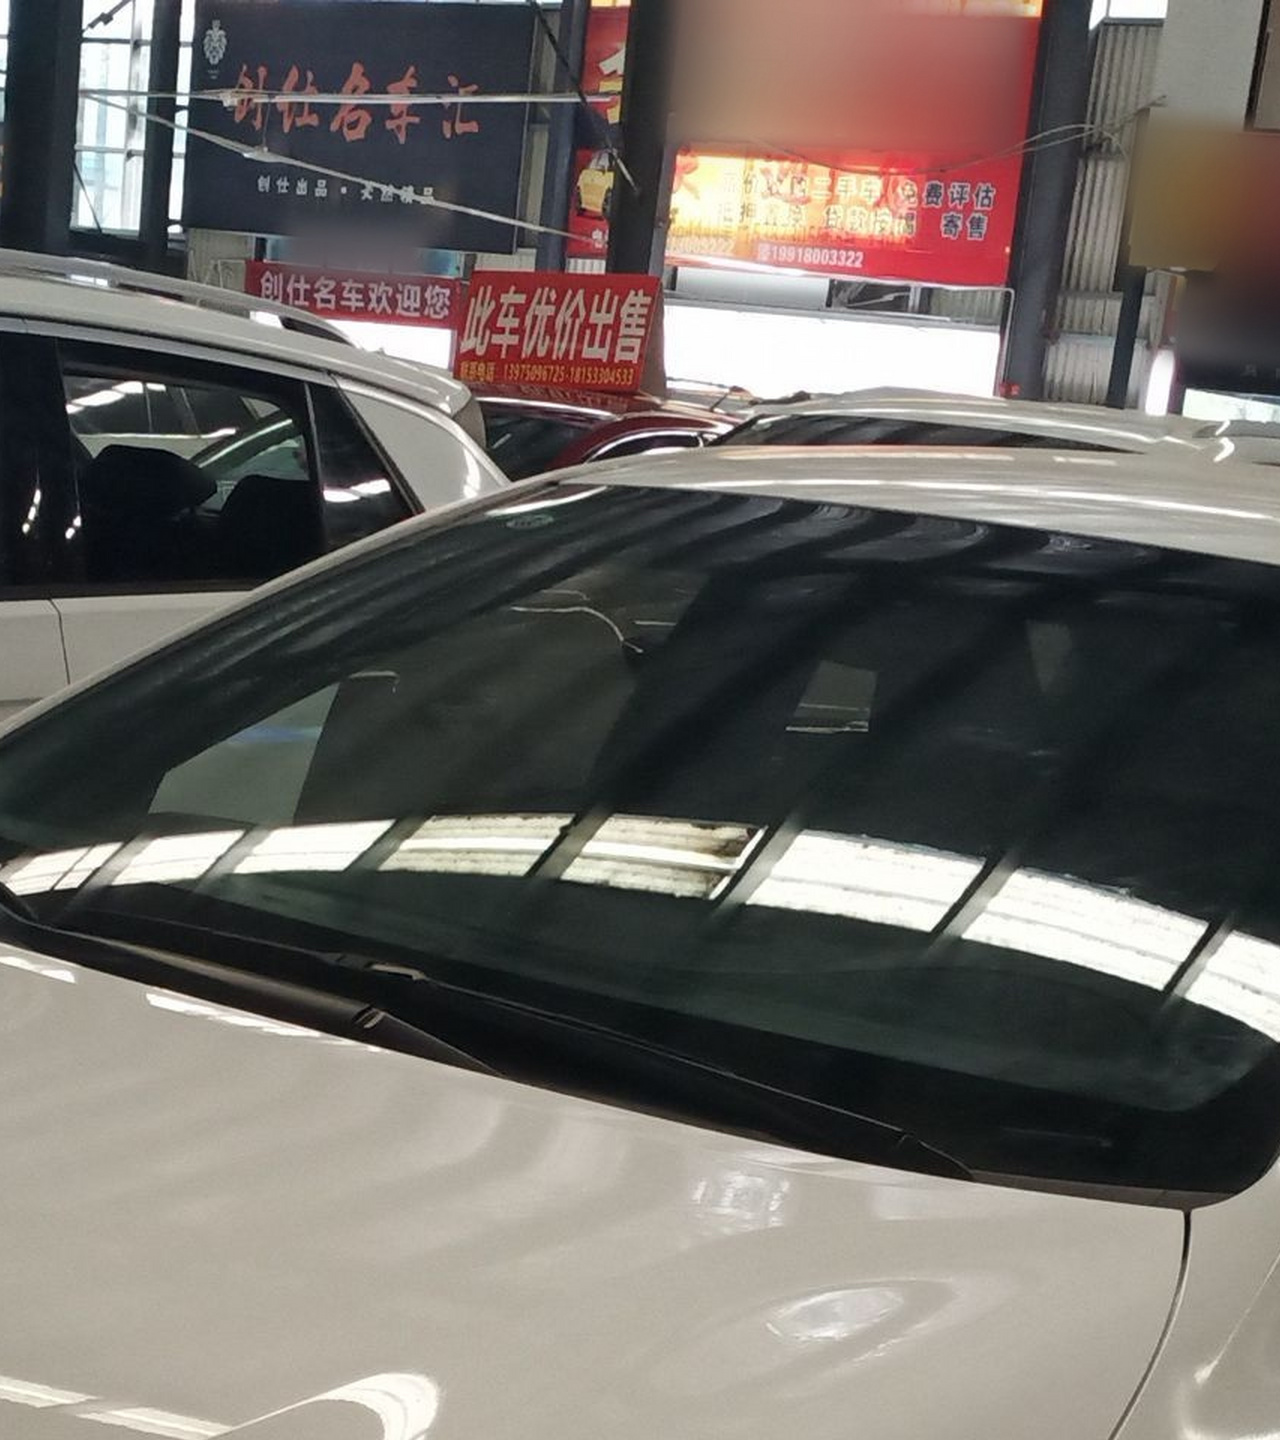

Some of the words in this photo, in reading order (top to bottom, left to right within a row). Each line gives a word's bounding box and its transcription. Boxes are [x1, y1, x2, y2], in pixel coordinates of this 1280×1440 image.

[897, 178, 996, 211] 免费评估
[940, 212, 990, 242] 寄售
[259, 269, 451, 320] 创仕名车欢迎您
[460, 284, 653, 365] 此车优价出售
